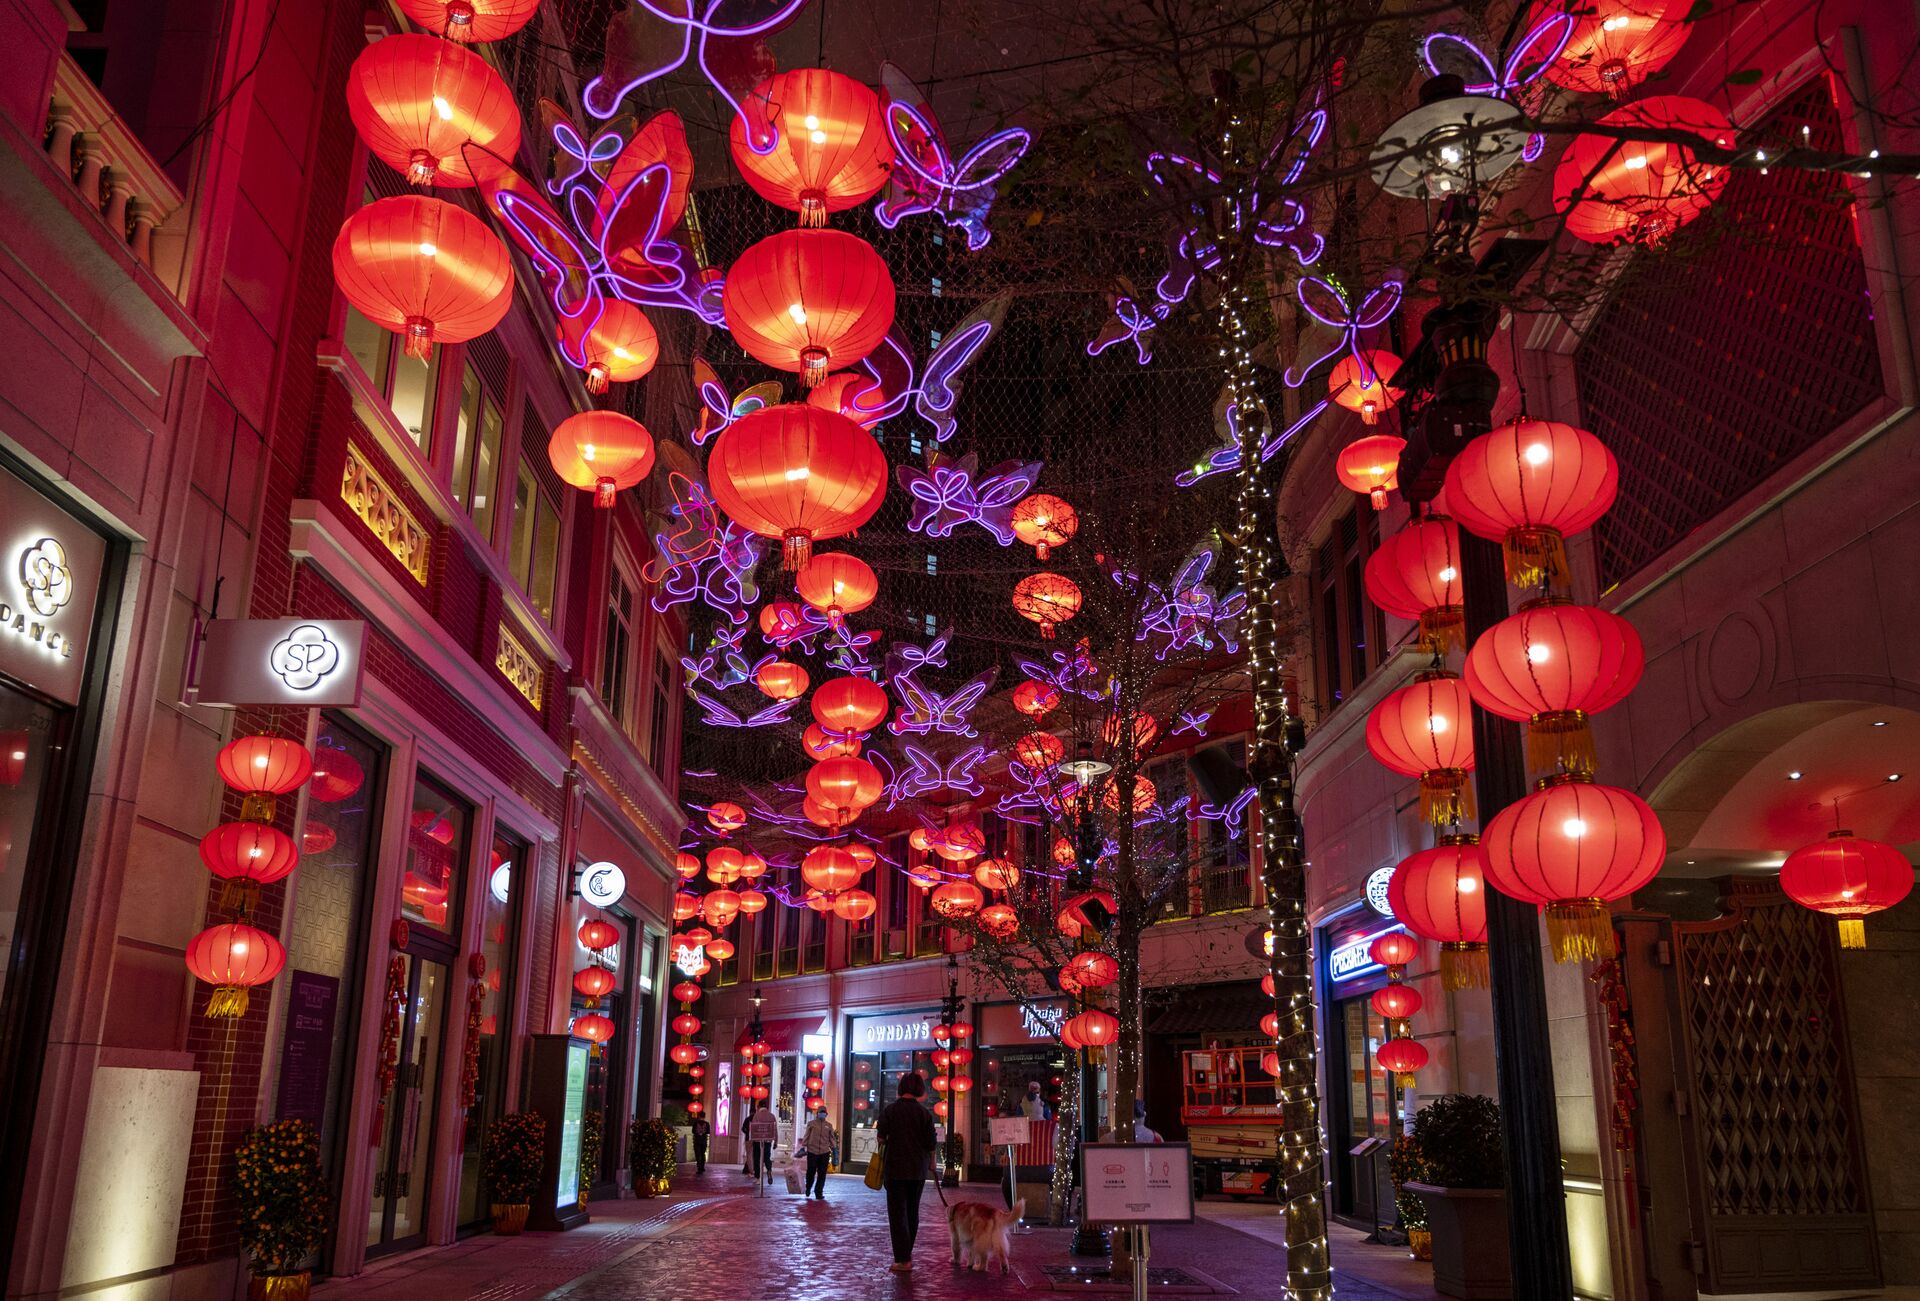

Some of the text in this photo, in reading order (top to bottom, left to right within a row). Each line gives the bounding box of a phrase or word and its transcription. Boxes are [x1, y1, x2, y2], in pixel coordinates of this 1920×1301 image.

[29, 556, 65, 597] SP
[284, 643, 326, 673] SP
[866, 1021, 929, 1042] OWNDAYS
